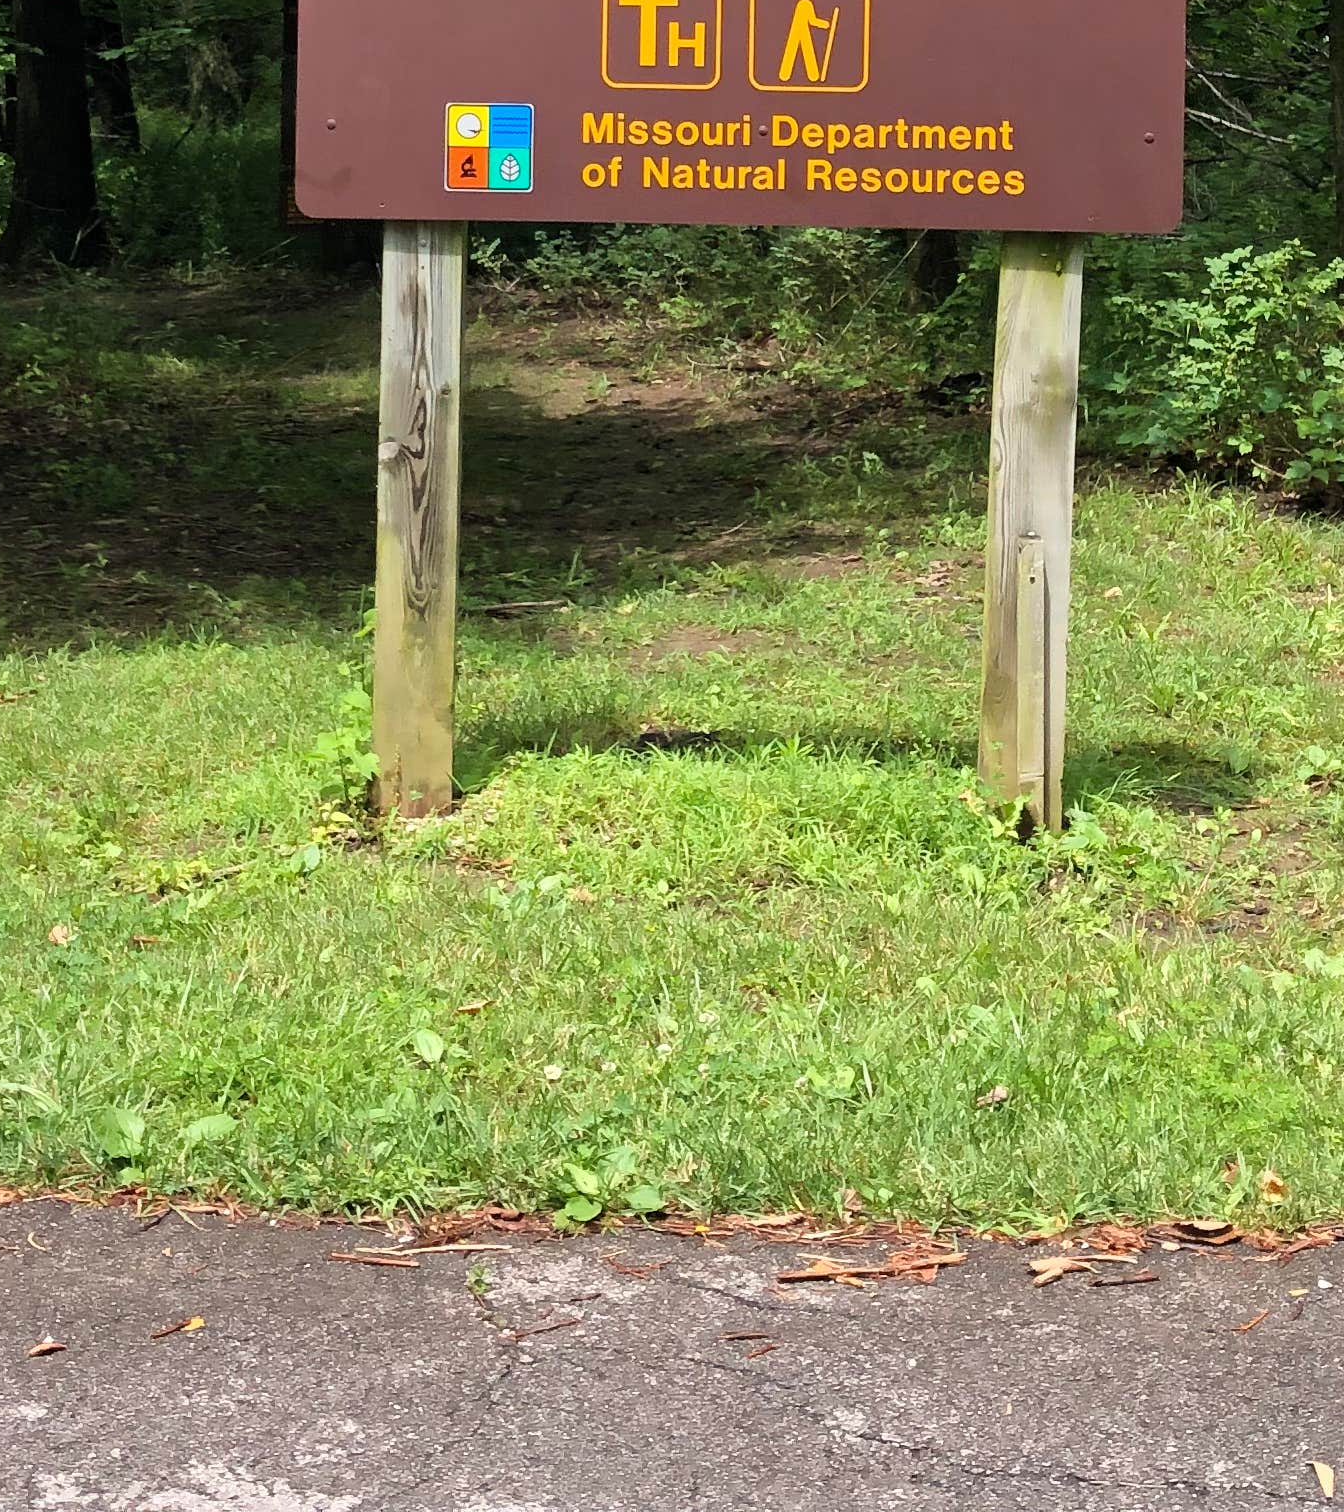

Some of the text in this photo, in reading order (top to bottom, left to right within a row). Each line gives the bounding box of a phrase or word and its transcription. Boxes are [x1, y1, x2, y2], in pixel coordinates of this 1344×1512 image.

[581, 111, 1014, 155] Missouri Department
[581, 155, 1025, 196] of Natural Resources
